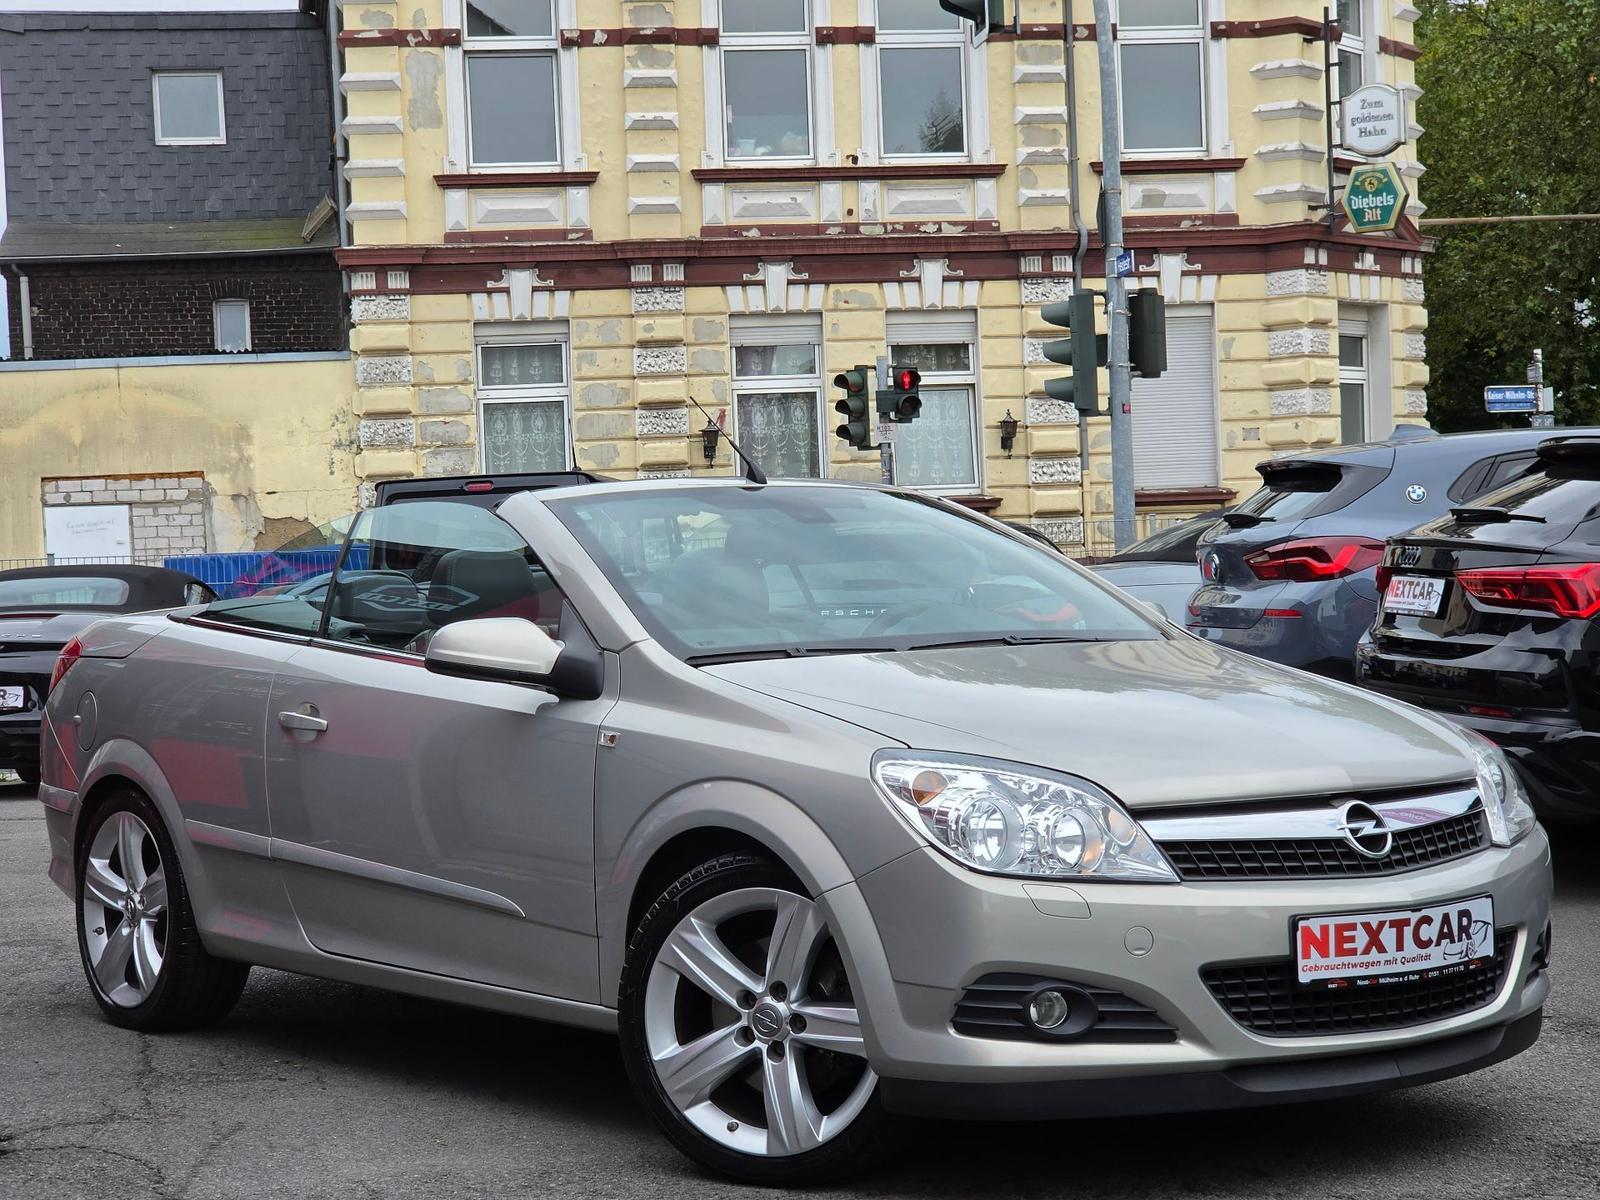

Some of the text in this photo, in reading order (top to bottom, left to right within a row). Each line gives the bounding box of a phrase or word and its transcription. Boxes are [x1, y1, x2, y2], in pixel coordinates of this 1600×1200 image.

[1360, 98, 1384, 109] Zum
[1351, 112, 1394, 126] goldenen
[1350, 192, 1395, 209] Diebels
[1363, 208, 1382, 221] Alt
[1388, 580, 1434, 600] NEXTCAR
[1301, 908, 1473, 960] NEXTCAR
[1302, 953, 1432, 973] Gebrauchtwagen mit Qualität
